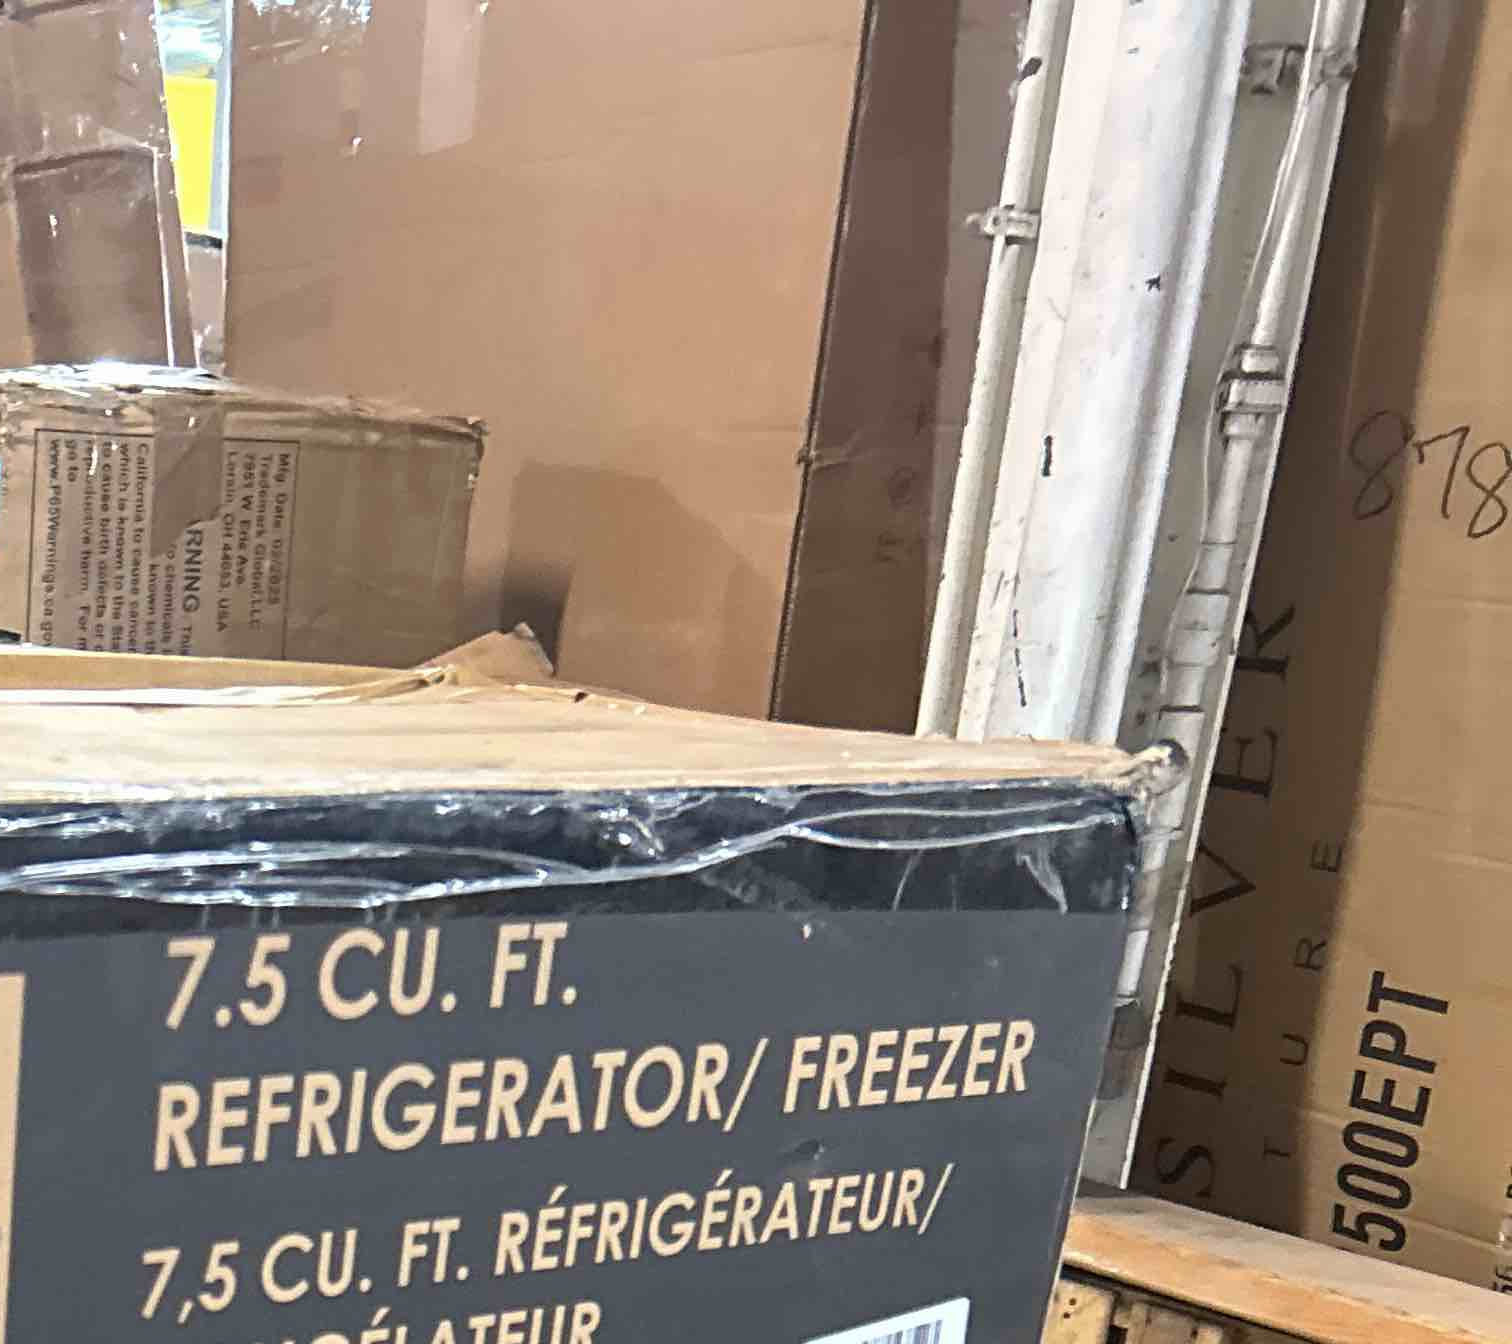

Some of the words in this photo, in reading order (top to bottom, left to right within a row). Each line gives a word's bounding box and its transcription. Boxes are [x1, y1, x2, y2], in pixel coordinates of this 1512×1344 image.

[1349, 409, 1512, 538] 878
[182, 529, 204, 613] RNING
[164, 935, 291, 1030] 7.5
[318, 928, 458, 1015] CU.
[489, 922, 578, 1008] FT.
[153, 1036, 769, 1171] REFRIGERATOR/
[782, 1018, 1037, 1115] FREEZER
[1331, 970, 1449, 1252] 500EPT
[139, 1242, 239, 1325] 7,5
[261, 1231, 372, 1304] CU.
[396, 1217, 470, 1288] FT.
[494, 1163, 956, 1275] RÉFRIGÉRATEUR/
